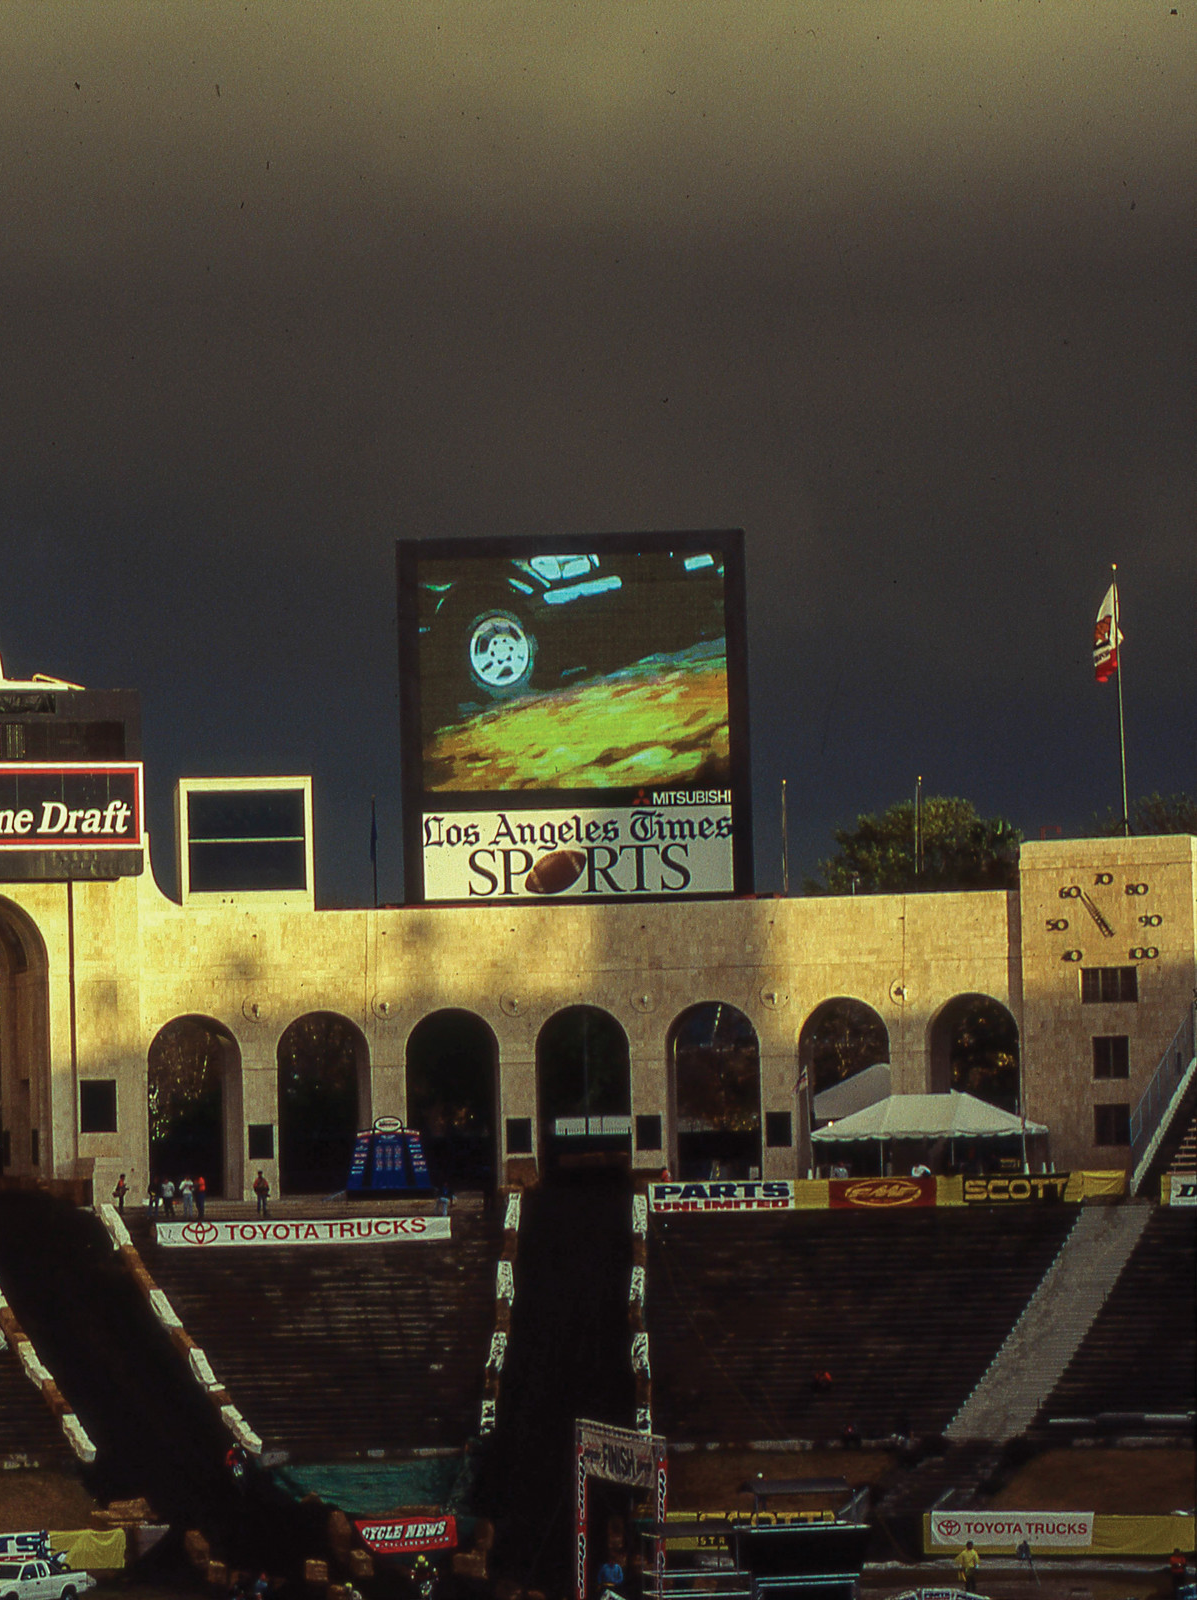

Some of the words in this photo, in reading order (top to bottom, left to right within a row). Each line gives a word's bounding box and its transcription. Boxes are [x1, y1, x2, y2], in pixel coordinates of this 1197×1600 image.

[652, 789, 732, 806] MITSUBISHI
[36, 801, 132, 835] Draft
[423, 815, 481, 848] Los
[488, 812, 620, 852] Angeles
[629, 810, 733, 843] Times
[1058, 885, 1082, 899] 60
[1124, 883, 1149, 896] 80
[1045, 918, 1069, 932] 50
[1138, 914, 1163, 928] 90
[1128, 946, 1159, 960] 100
[653, 1182, 790, 1199] PARTS
[964, 1177, 1071, 1200] SCOTT
[653, 1199, 790, 1212] UNLIMITED
[225, 1223, 320, 1241] TOYOTA
[321, 1217, 428, 1240] TRUCKS
[362, 1524, 404, 1541] CYCLE
[405, 1520, 447, 1539] NEWS
[964, 1522, 1023, 1535] TOYOTA
[1026, 1522, 1088, 1535] TRUCKS
